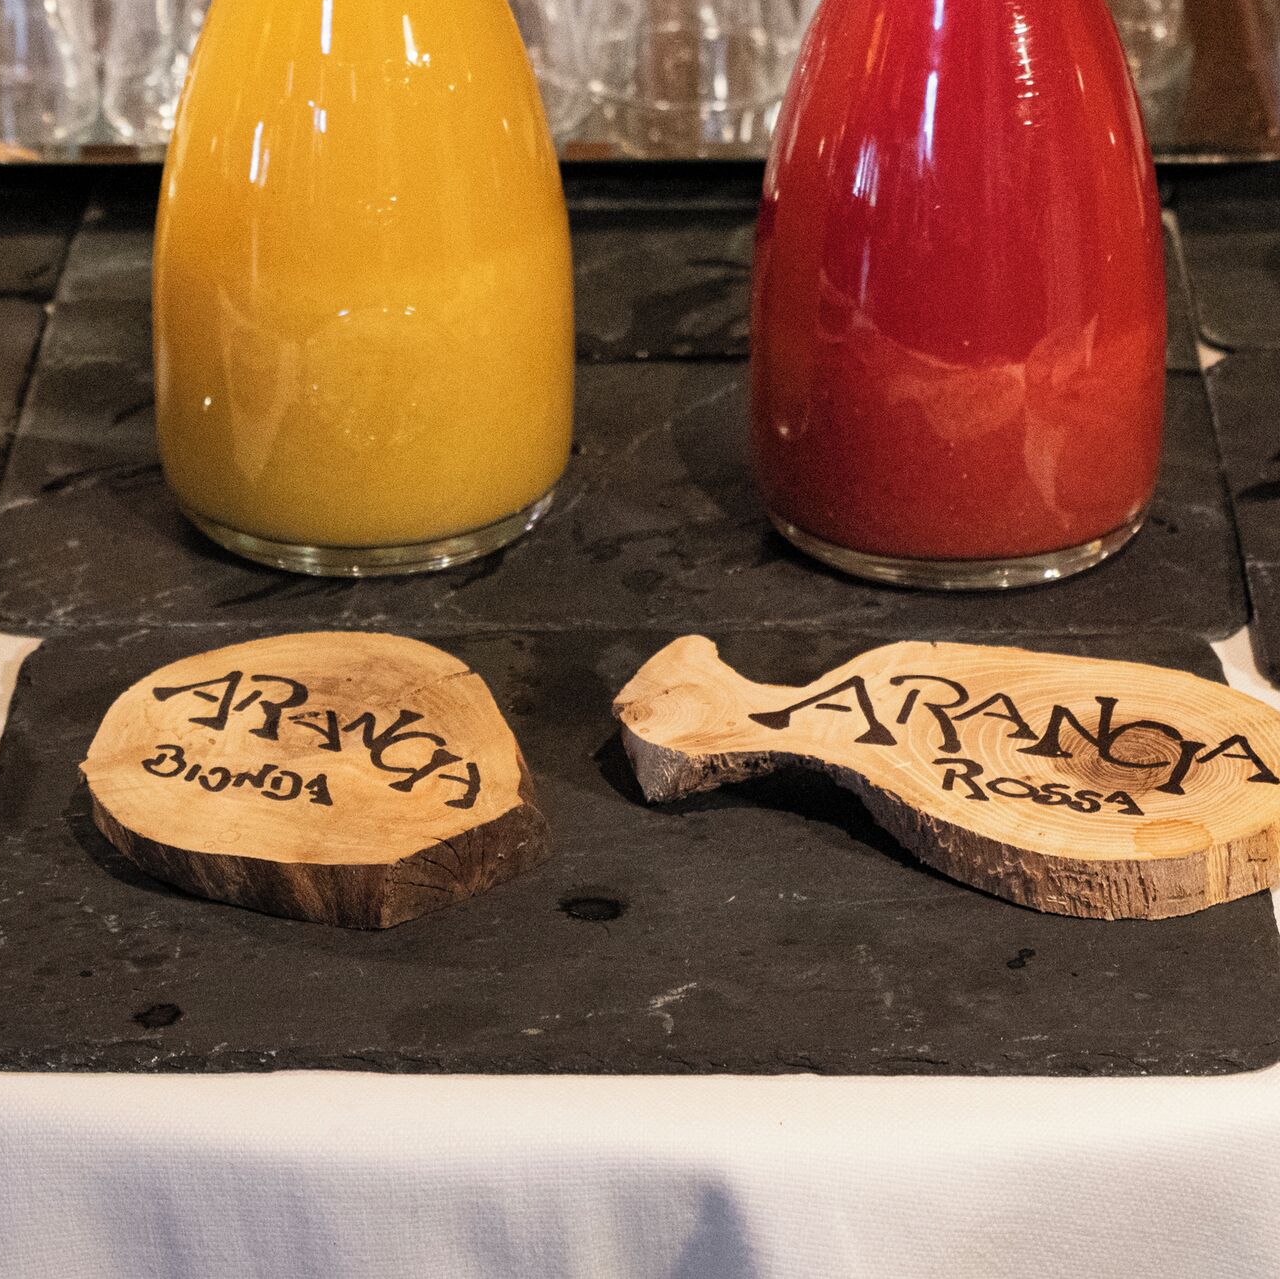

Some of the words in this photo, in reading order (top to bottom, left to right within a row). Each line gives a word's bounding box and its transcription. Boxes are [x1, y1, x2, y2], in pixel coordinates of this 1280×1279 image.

[141, 743, 333, 806] BIONDA
[152, 670, 482, 810] ARANCIA
[748, 675, 1280, 795] ARANCIA
[931, 757, 1145, 816] ROSSA
